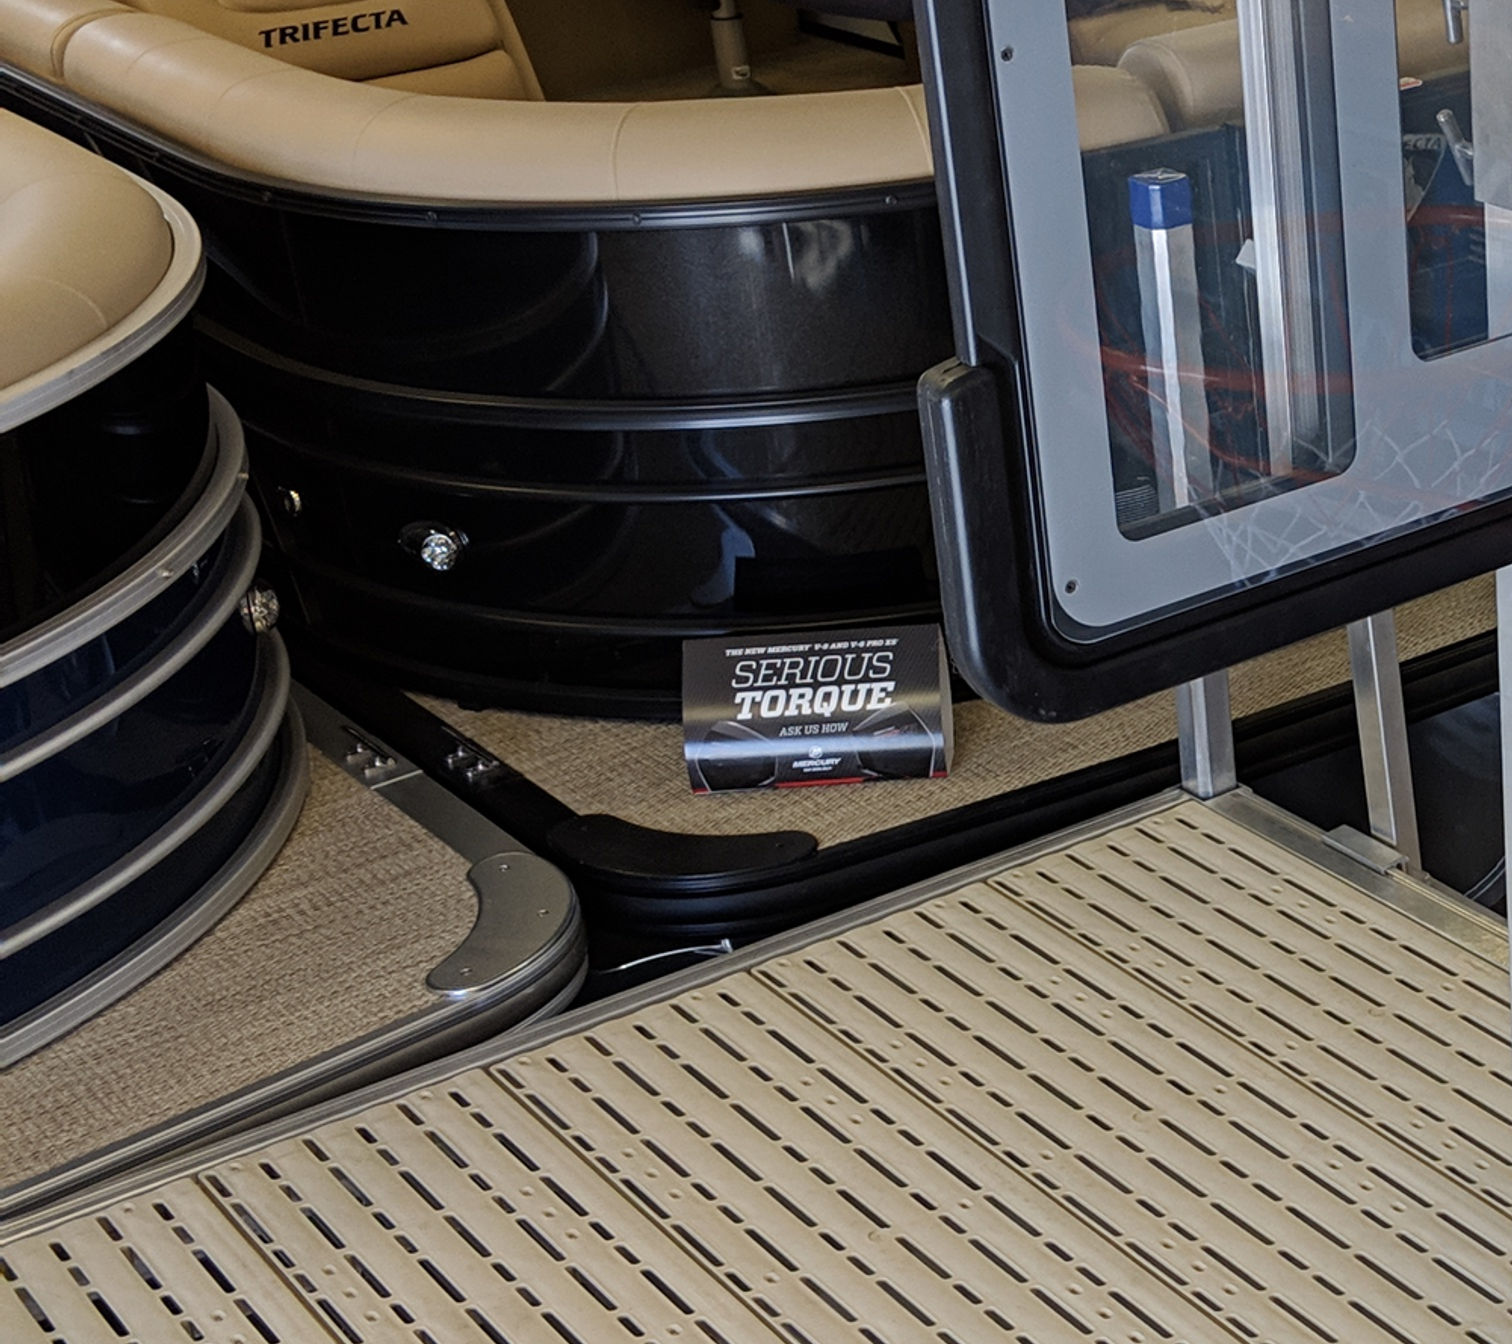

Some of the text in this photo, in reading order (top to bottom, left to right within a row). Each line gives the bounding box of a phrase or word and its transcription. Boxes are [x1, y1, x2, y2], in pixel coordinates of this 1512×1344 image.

[259, 8, 408, 49] TRIFECTA
[725, 647, 744, 657] THE
[744, 646, 766, 656] NEW
[767, 644, 811, 655] MERCURY
[829, 641, 849, 650] AND
[866, 638, 884, 648] PRO
[731, 651, 894, 689] SERIOUS
[734, 680, 897, 721] TORQUE
[779, 721, 849, 737] ASK US HOW
[792, 757, 841, 769] MERCURY
